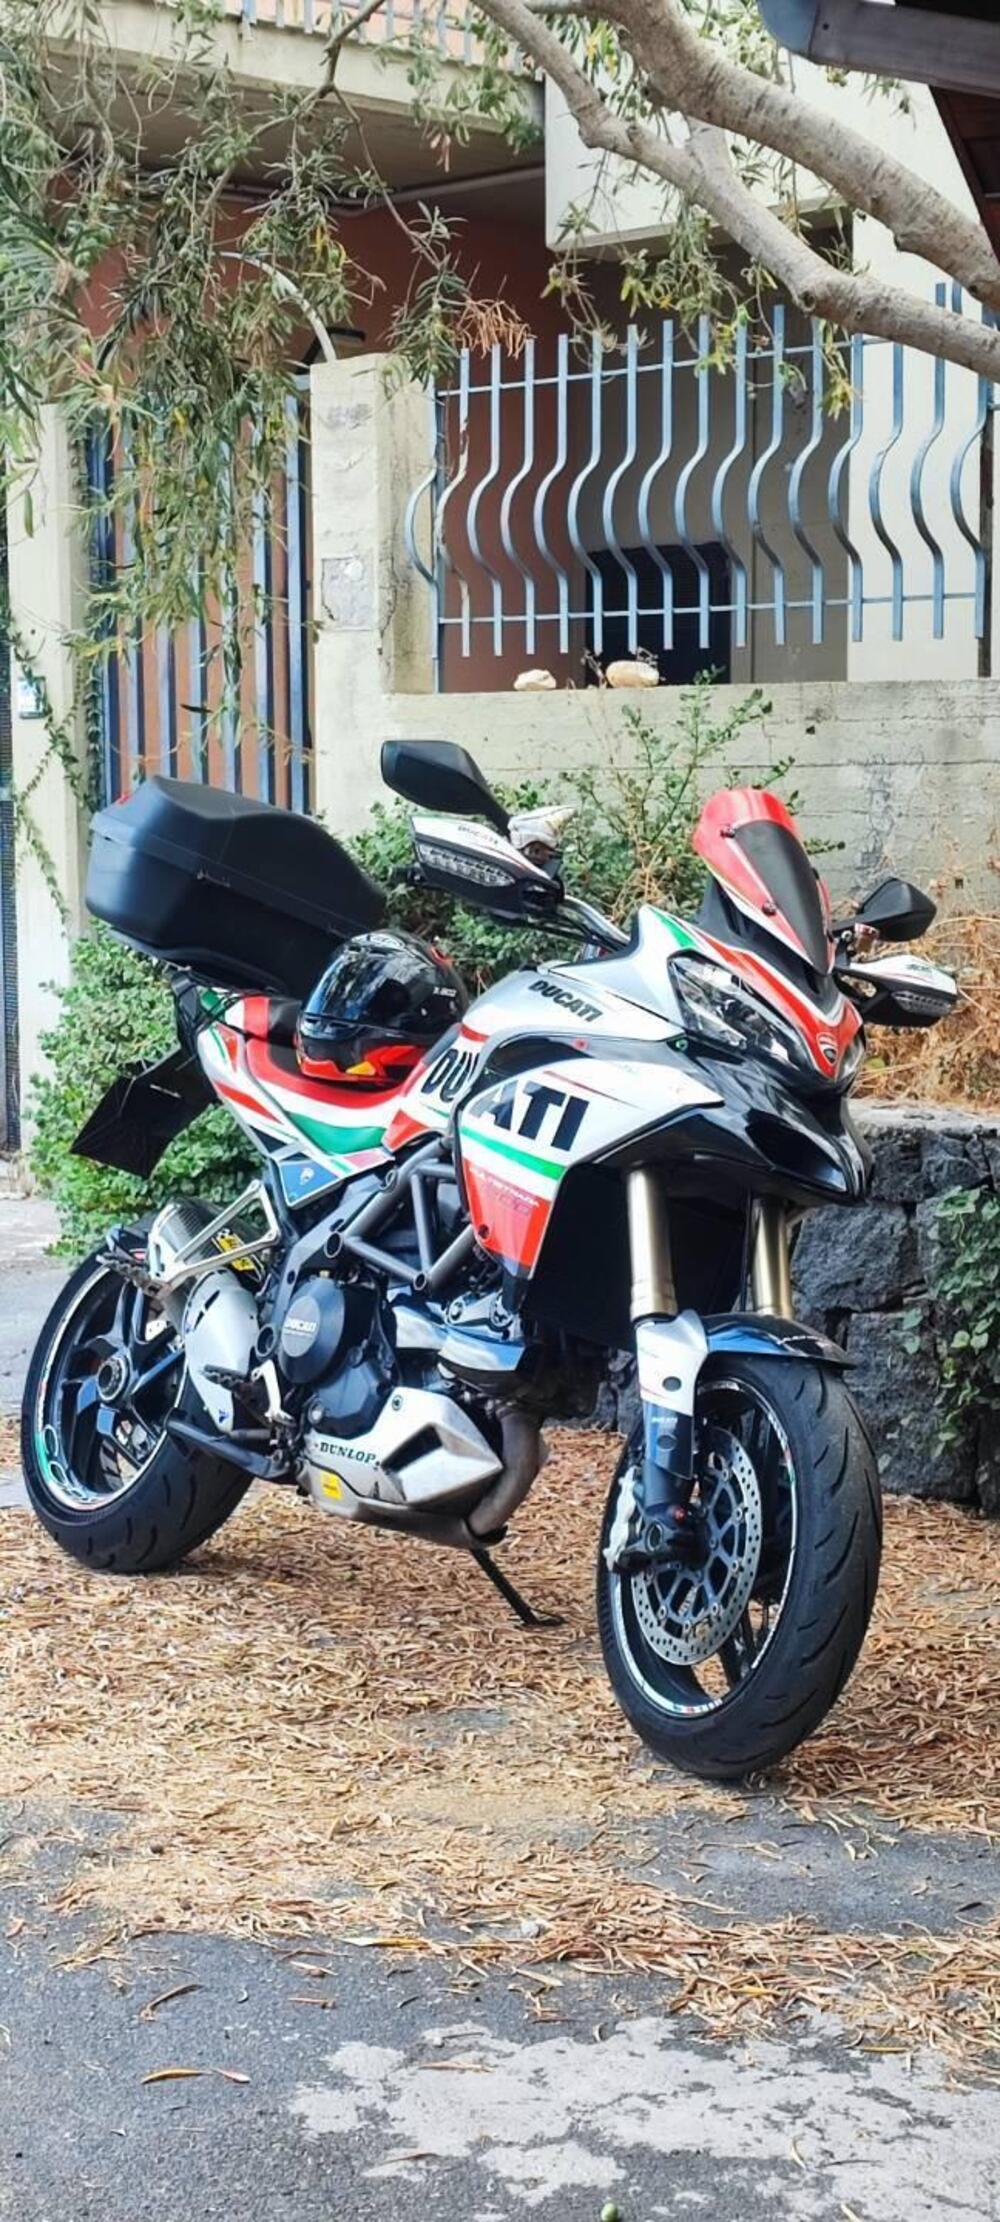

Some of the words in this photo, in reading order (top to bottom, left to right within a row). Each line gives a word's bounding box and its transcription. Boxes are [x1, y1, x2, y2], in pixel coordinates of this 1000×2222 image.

[528, 979, 603, 1022] DUCATI
[420, 1048, 590, 1152] DUATI
[319, 1441, 377, 1464] DUNLOP
